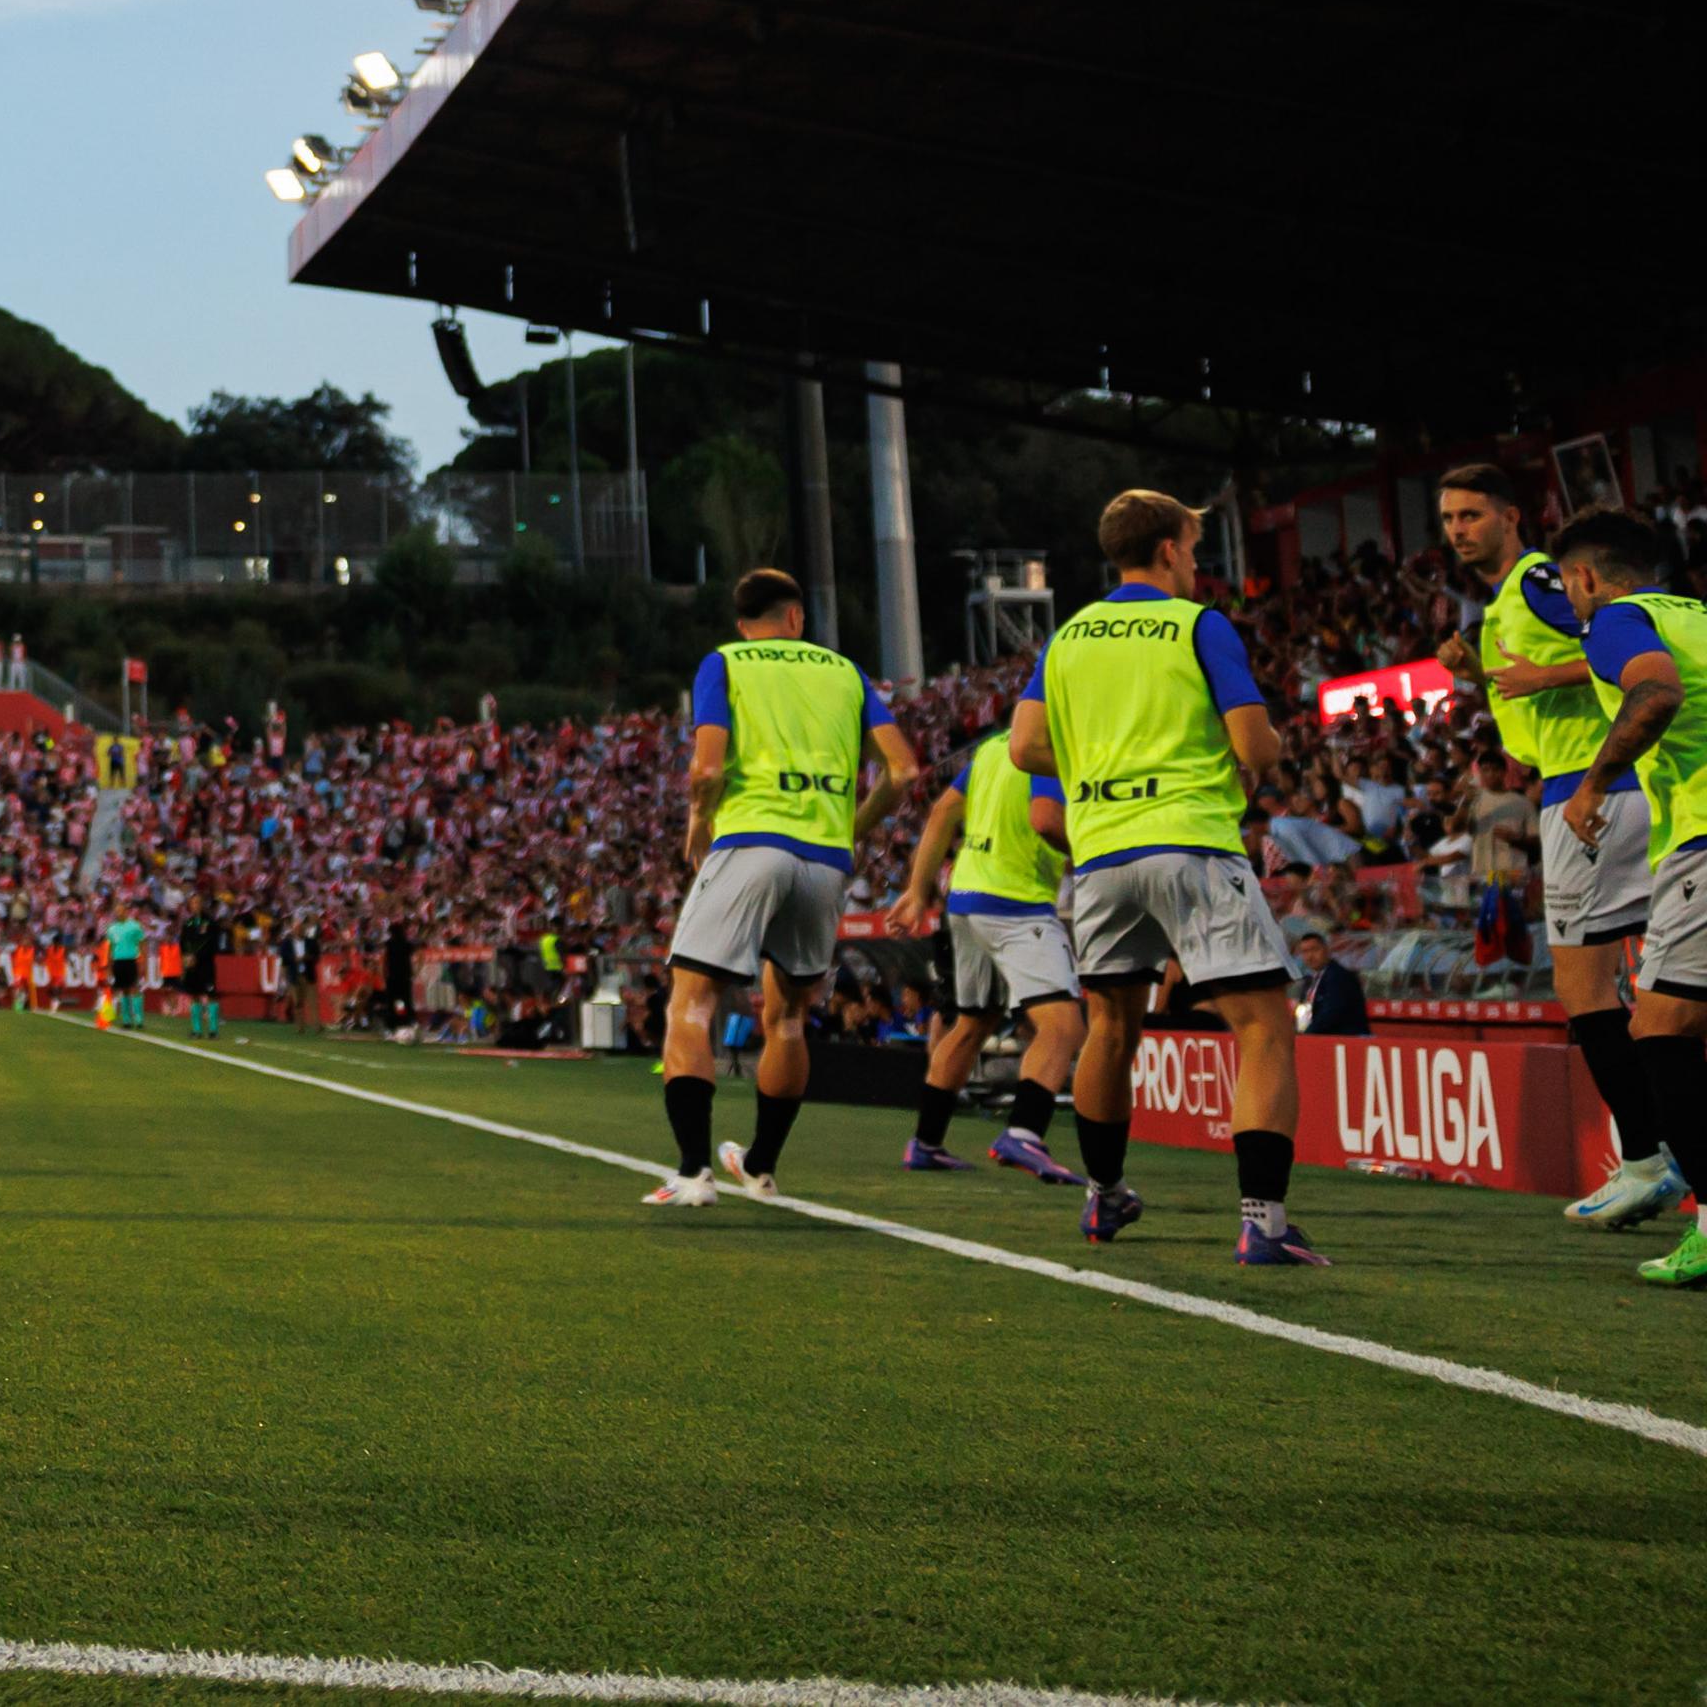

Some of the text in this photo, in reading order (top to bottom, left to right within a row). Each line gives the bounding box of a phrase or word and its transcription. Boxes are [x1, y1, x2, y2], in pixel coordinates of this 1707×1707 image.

[1062, 619, 1180, 642] macron
[734, 647, 846, 667] macron
[1334, 1044, 1503, 1172] LALIGA
